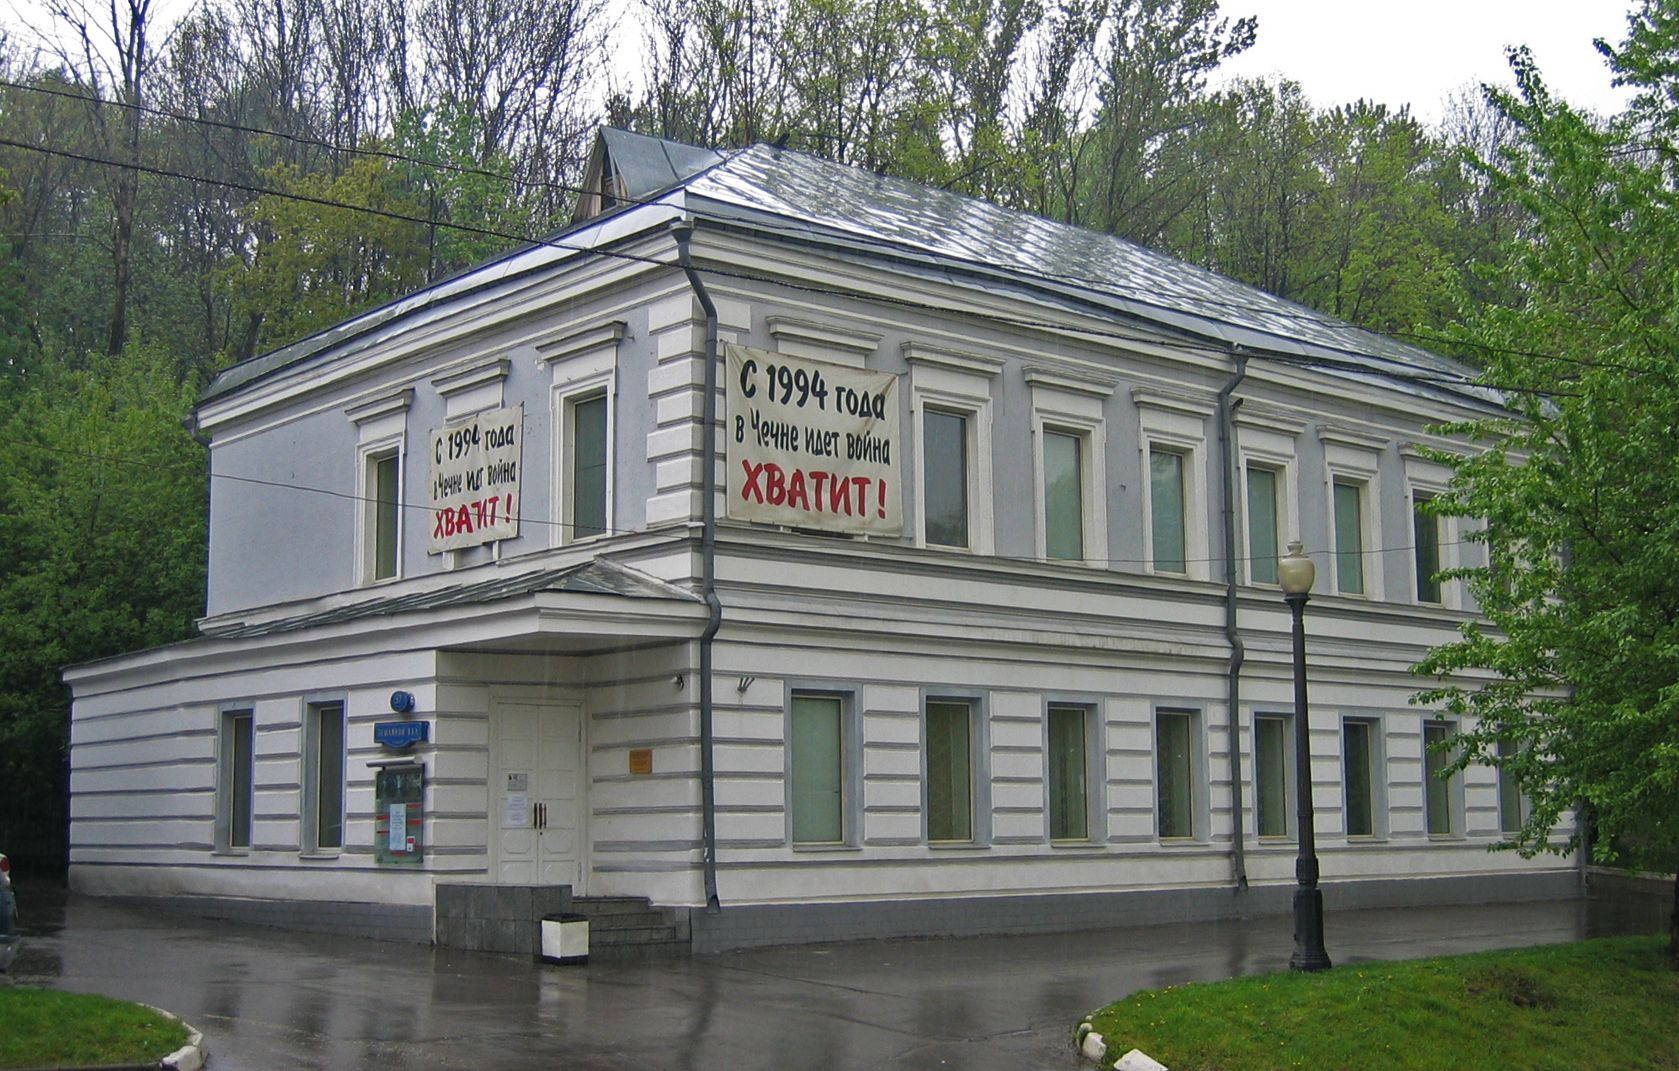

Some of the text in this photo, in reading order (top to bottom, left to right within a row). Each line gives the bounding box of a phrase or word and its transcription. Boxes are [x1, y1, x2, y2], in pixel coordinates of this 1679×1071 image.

[740, 359, 886, 421] С 1994 года
[435, 424, 515, 465] С 1994 года
[735, 407, 891, 466] в Чечне идет война
[487, 459, 516, 486] война
